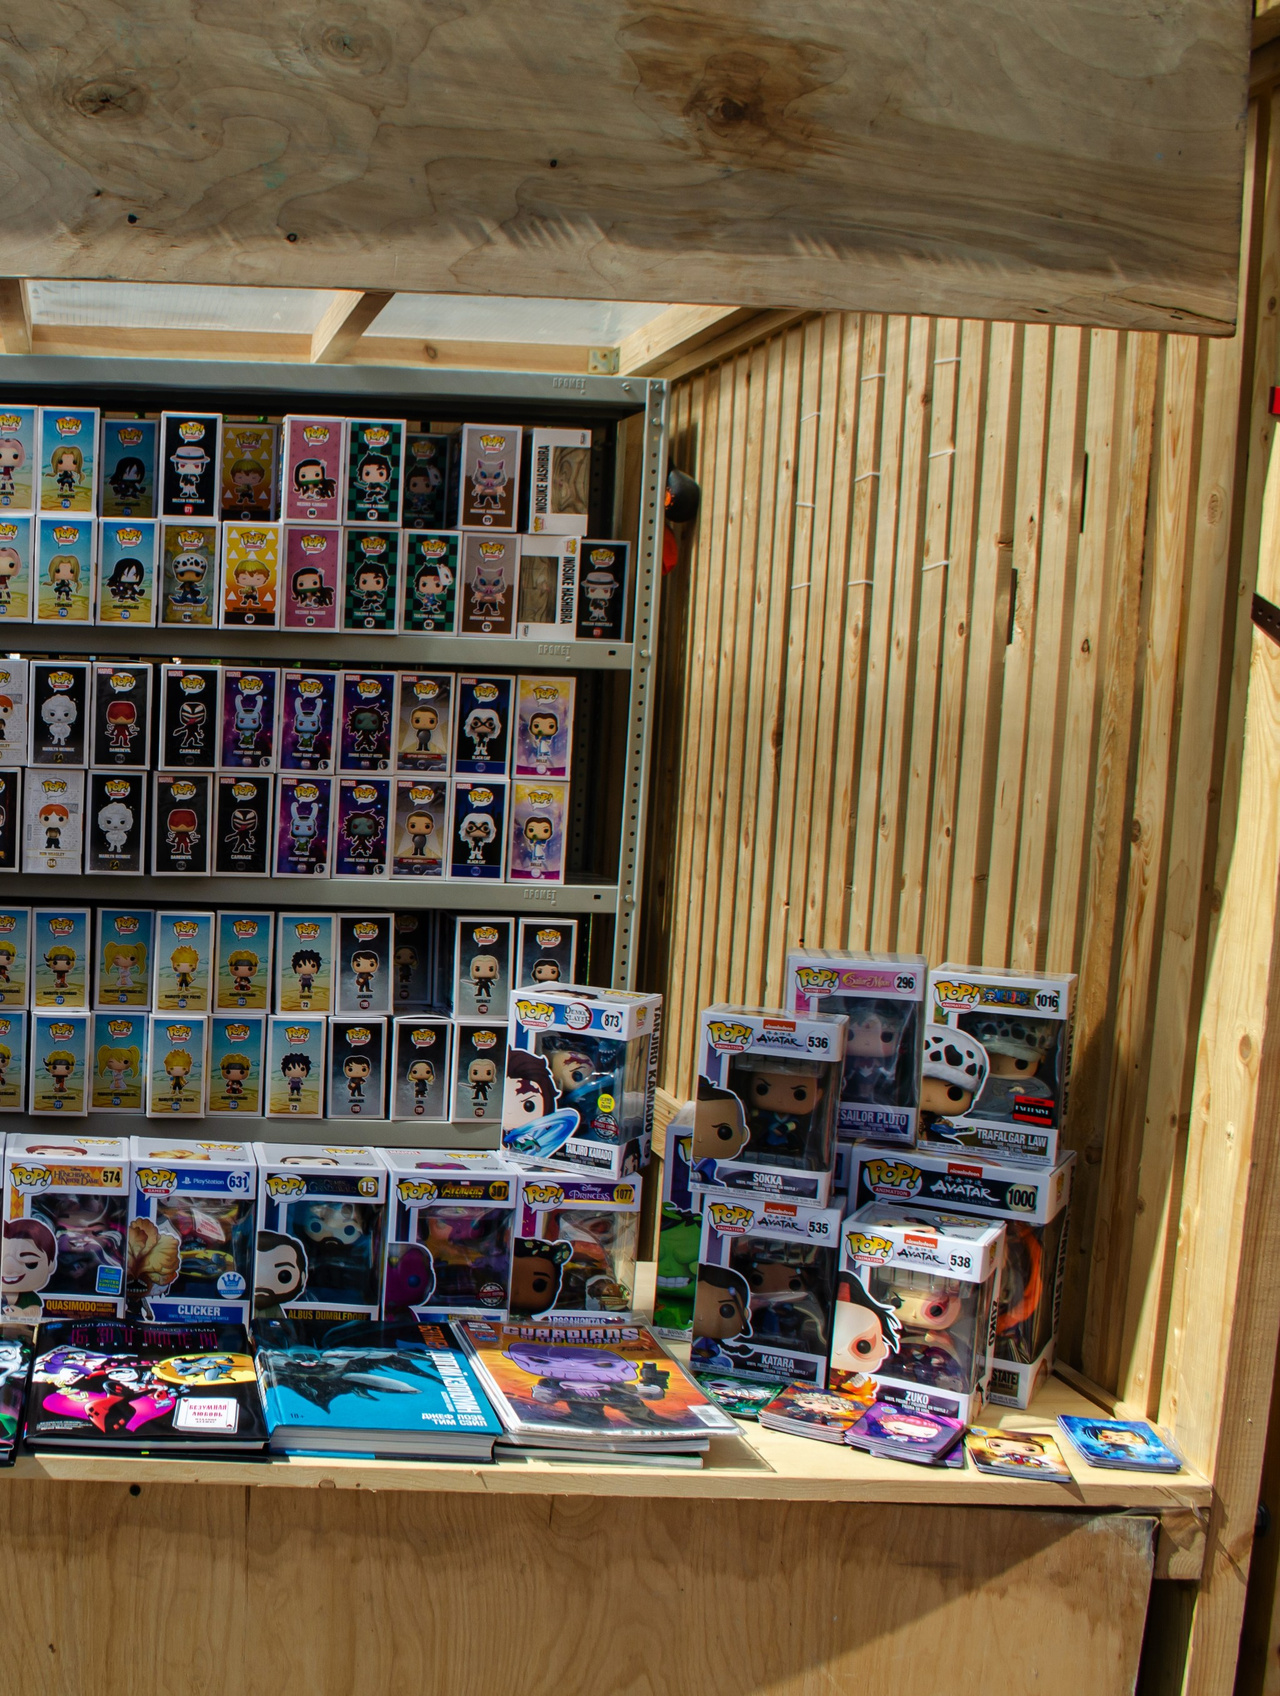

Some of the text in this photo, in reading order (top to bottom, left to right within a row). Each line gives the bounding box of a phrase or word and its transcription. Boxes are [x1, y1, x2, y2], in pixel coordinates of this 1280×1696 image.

[363, 428, 390, 443] POP!
[536, 444, 550, 514] INOSUKE HASHIBIRA
[560, 556, 576, 624] INOSUKE HASHIBIRA
[796, 968, 839, 988] POP!
[896, 977, 914, 989] 296
[934, 982, 979, 1002] POP!
[1036, 994, 1058, 1008] 1016
[515, 1001, 555, 1020] POP!
[604, 1016, 619, 1027] 873
[707, 1022, 753, 1044] POP!
[756, 1036, 804, 1047] AVATAR
[808, 1037, 828, 1048] 536
[645, 1004, 662, 1134] TANJIRO KAMADO
[1015, 1105, 1049, 1115] EXCLUSIVE
[841, 1110, 907, 1126] SAILOR PLUTO
[978, 1129, 1047, 1147] TRAFALGAR LAW
[566, 1143, 612, 1160] TANJIRO KAMADO
[10, 1167, 50, 1186] POP!
[102, 1170, 120, 1183] 574
[136, 1169, 177, 1189] POP!
[753, 1173, 782, 1185] SOKKA
[864, 1159, 921, 1189] POP!
[193, 1178, 224, 1186] PlayStation
[229, 1175, 248, 1188] 631
[266, 1178, 305, 1197] POP!
[361, 1181, 375, 1193] 15
[396, 1182, 437, 1200] POP!
[491, 1185, 507, 1196] 307
[522, 1185, 564, 1204] POP!
[569, 1190, 610, 1201] PRINCESS
[930, 1180, 1000, 1201] AVATAR
[1009, 1189, 1035, 1207] 1000
[708, 1204, 755, 1226] POP!
[757, 1217, 804, 1231] AVATAR
[809, 1221, 828, 1235] 535
[846, 1234, 893, 1258] POP!
[897, 1250, 945, 1264] AVATAR
[951, 1254, 972, 1268] 538
[46, 1300, 96, 1311] QUASIMODO
[178, 1305, 221, 1316] CLICKER
[288, 1310, 368, 1321] ALBUS DUMBLEDORE
[502, 1326, 639, 1340] GUARDIANS
[762, 1354, 794, 1369] KATARA
[905, 1391, 929, 1404] ZUKO
